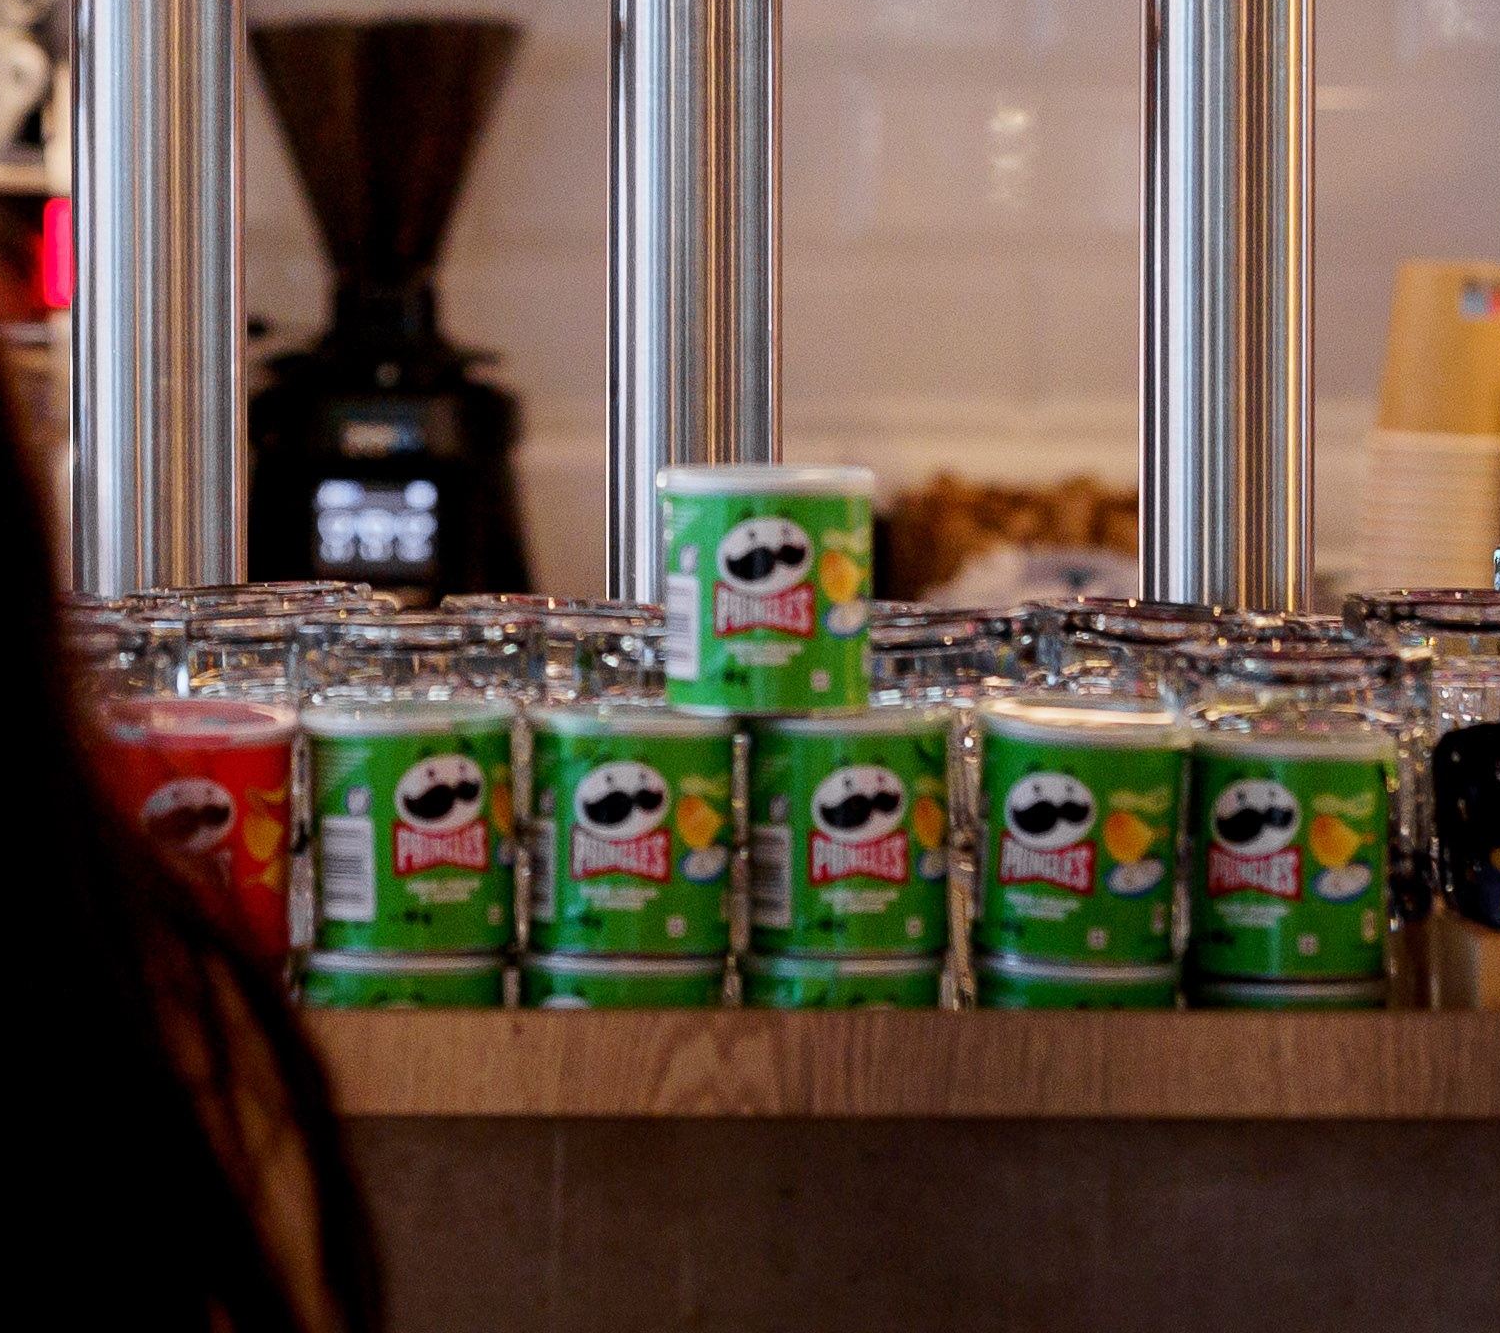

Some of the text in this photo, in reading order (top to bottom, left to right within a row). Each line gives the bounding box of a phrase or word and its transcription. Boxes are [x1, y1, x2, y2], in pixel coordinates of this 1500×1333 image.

[715, 585, 812, 635] PRINGLES
[573, 831, 670, 881] PRINGLES
[811, 832, 909, 883] PRINGLES
[1001, 843, 1095, 893] PRINGLES
